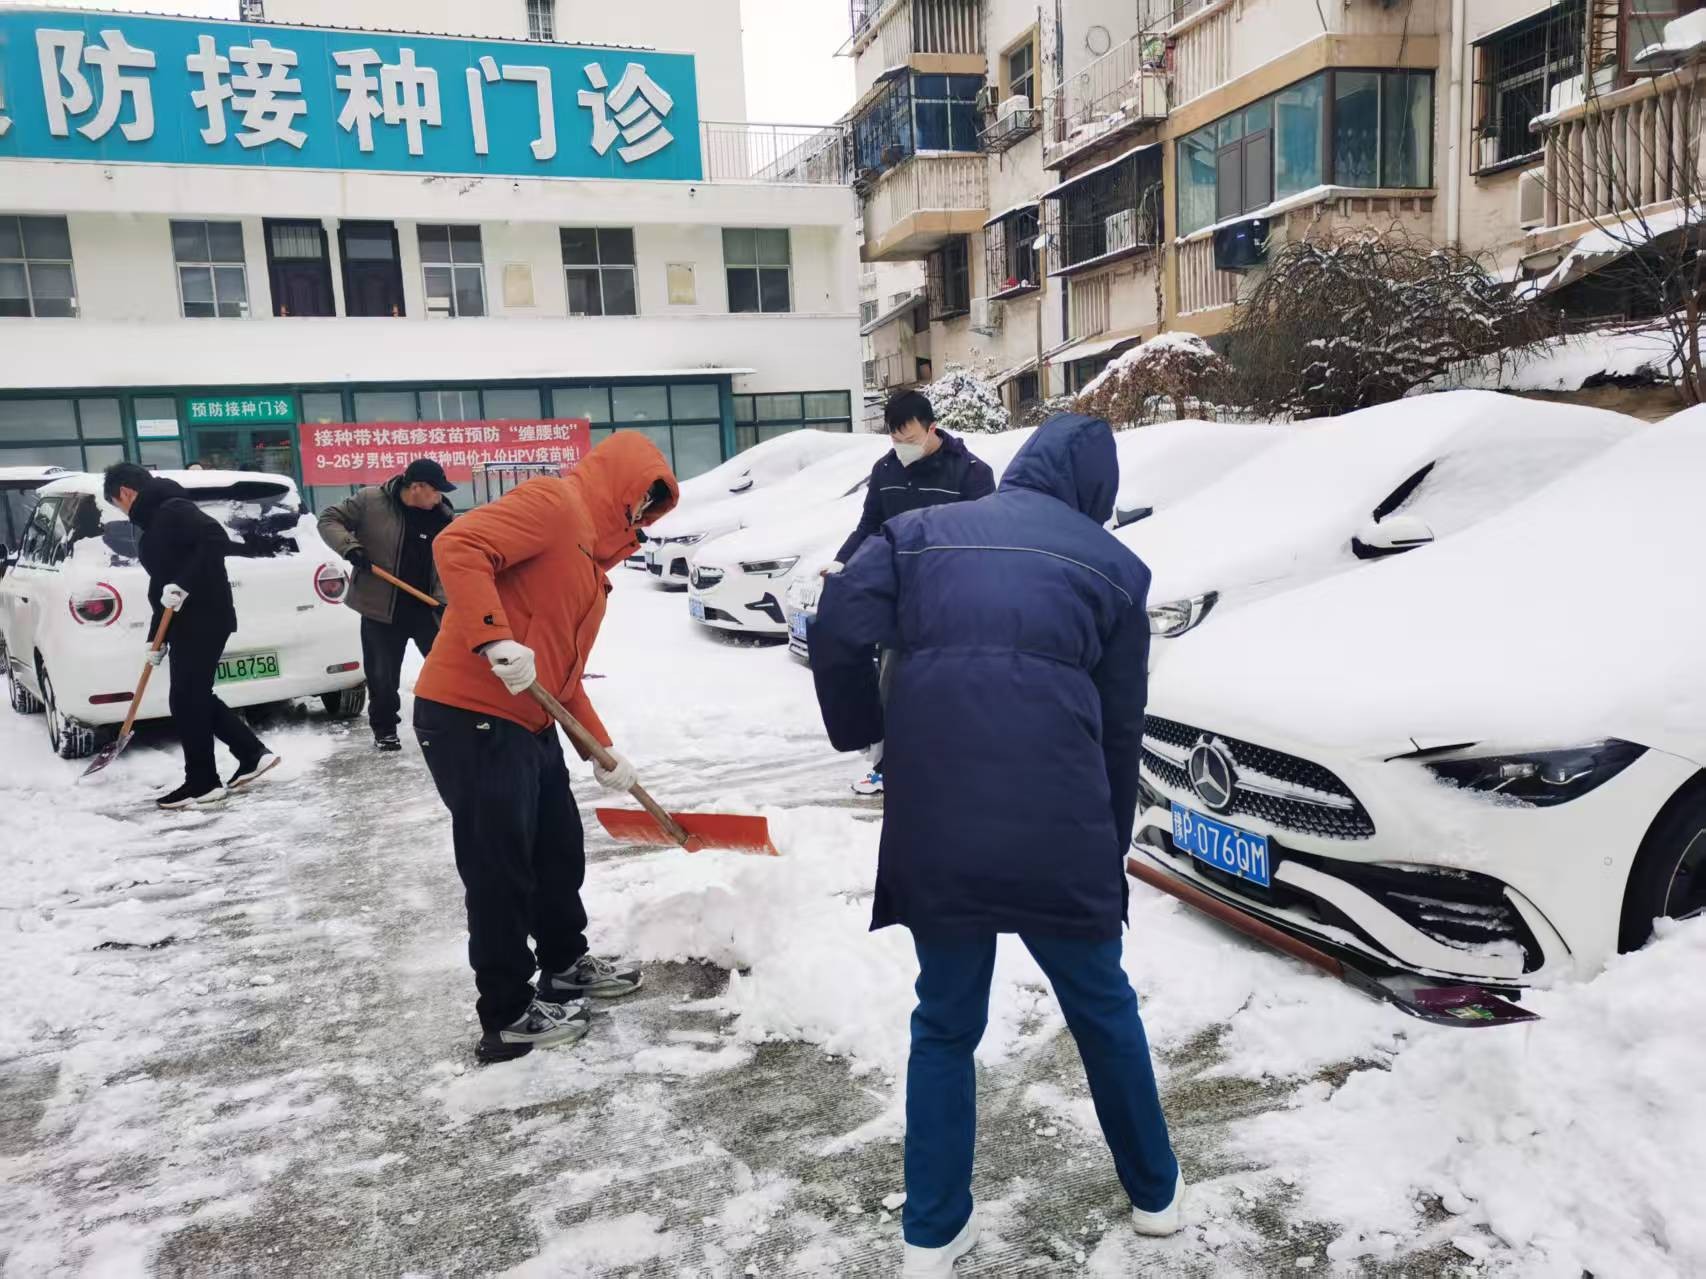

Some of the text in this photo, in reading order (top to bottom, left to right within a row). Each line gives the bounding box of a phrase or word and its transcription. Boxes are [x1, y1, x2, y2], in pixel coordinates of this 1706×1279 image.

[0, 29, 674, 163] 防接种门诊
[191, 400, 289, 417] 预防接种门诊
[217, 656, 277, 680] DL8758
